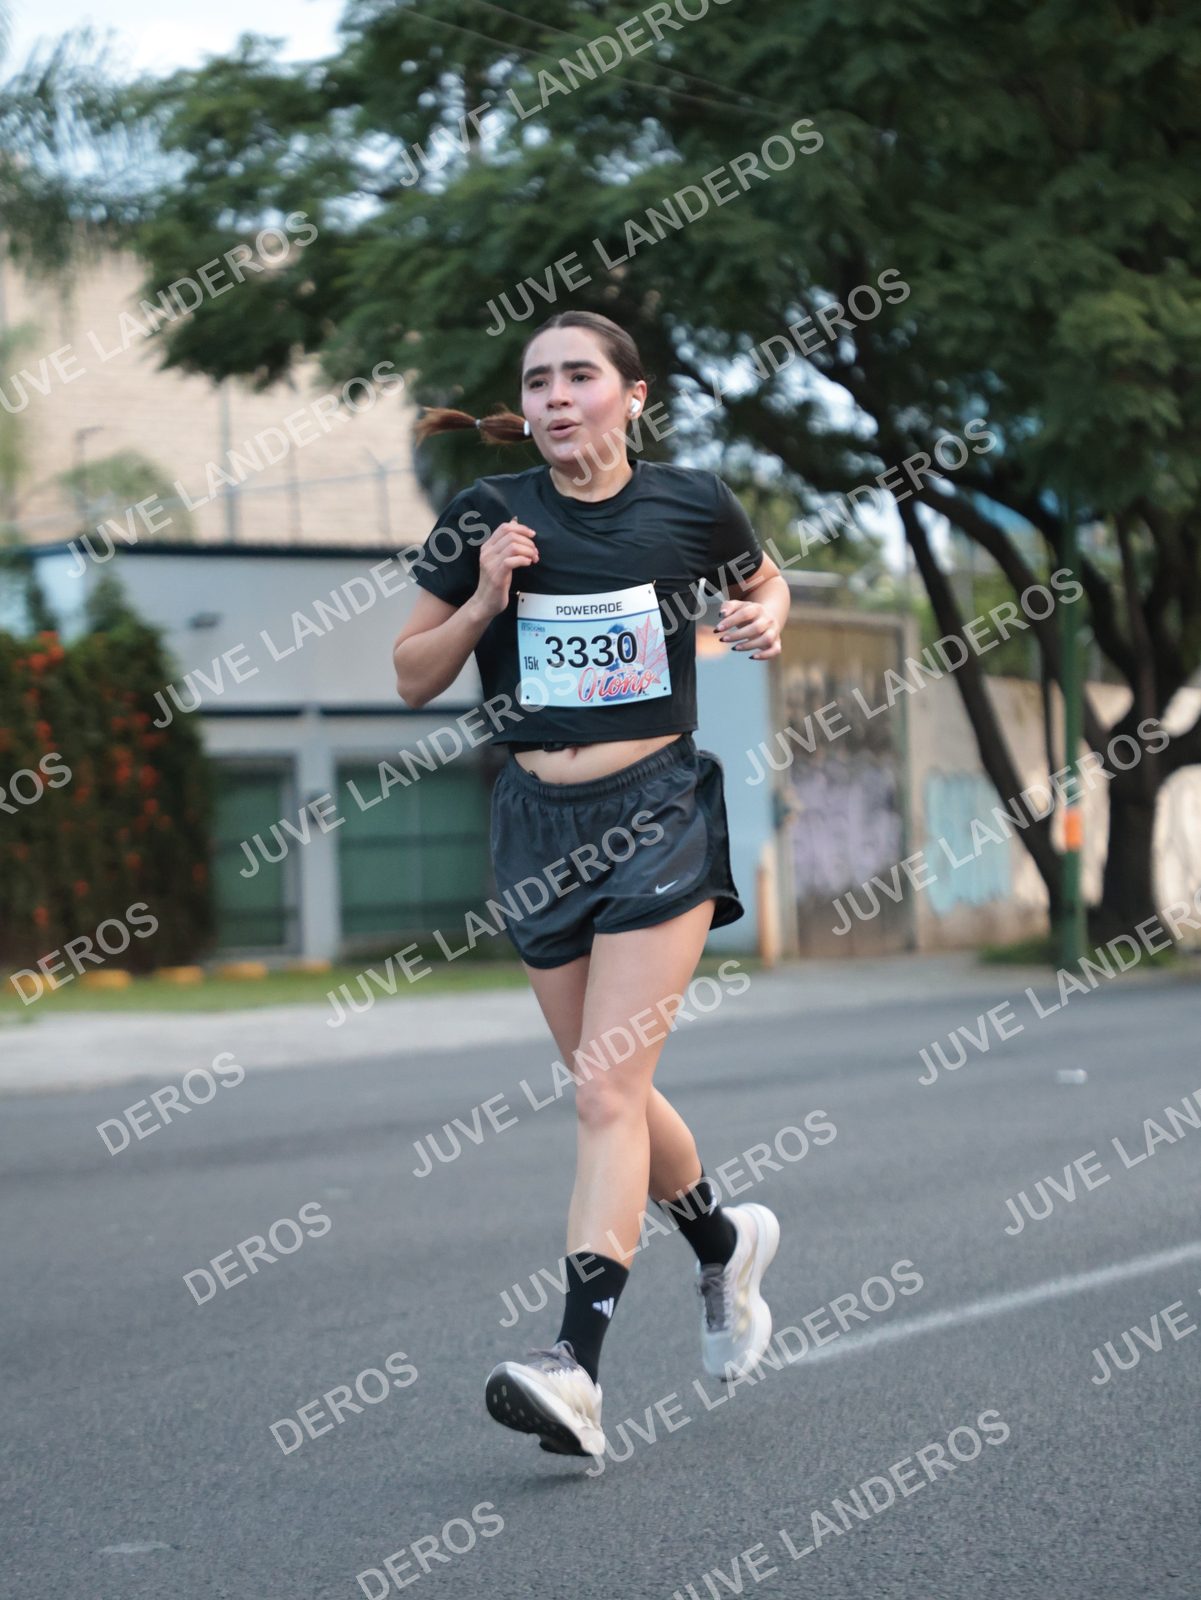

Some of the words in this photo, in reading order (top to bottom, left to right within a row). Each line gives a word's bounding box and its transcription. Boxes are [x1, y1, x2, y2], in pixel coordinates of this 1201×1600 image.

[556, 601, 623, 616] POWERADE
[545, 631, 638, 668] 3330
[524, 656, 540, 670] 15k
